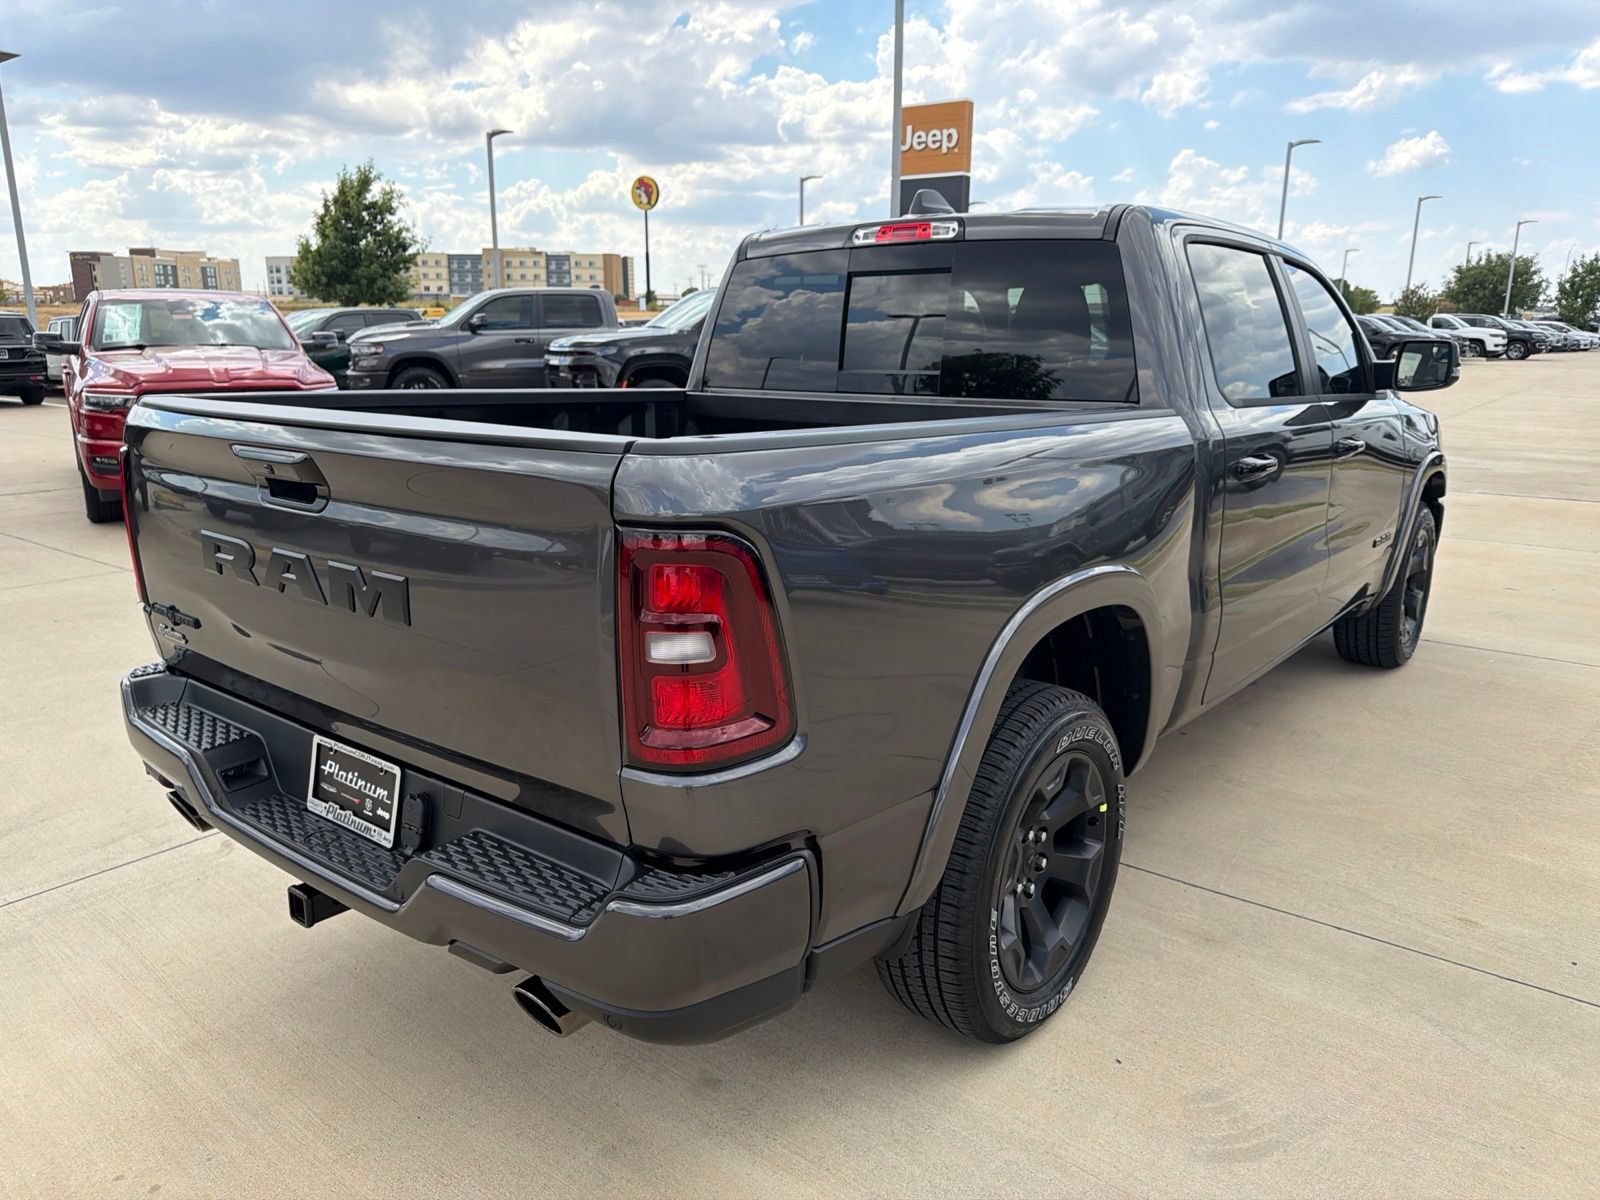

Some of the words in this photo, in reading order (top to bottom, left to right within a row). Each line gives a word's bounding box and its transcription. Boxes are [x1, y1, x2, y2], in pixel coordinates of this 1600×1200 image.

[900, 124, 958, 155] Jeep
[201, 528, 411, 627] RAM
[1056, 726, 1120, 771] DUELER
[320, 760, 391, 804] Platinum
[326, 803, 376, 838] Platinum
[989, 908, 1074, 1022] BRIDGESTONE
